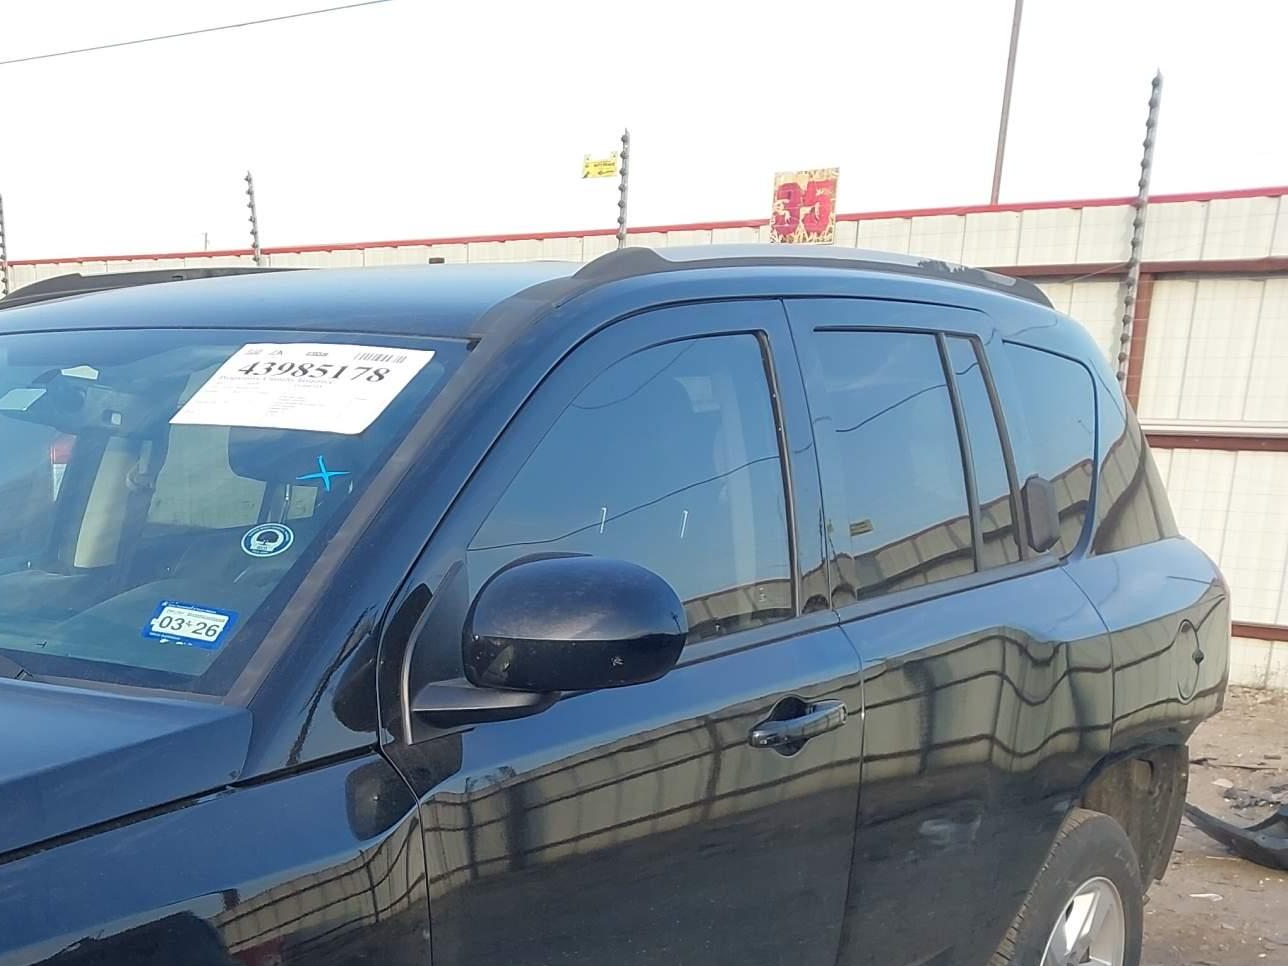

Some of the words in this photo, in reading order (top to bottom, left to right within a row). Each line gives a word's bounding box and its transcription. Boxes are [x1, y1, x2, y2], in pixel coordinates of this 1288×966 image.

[774, 178, 835, 235] 35
[238, 360, 391, 383] 43985178
[158, 615, 186, 631] 03
[191, 621, 220, 638] 26
